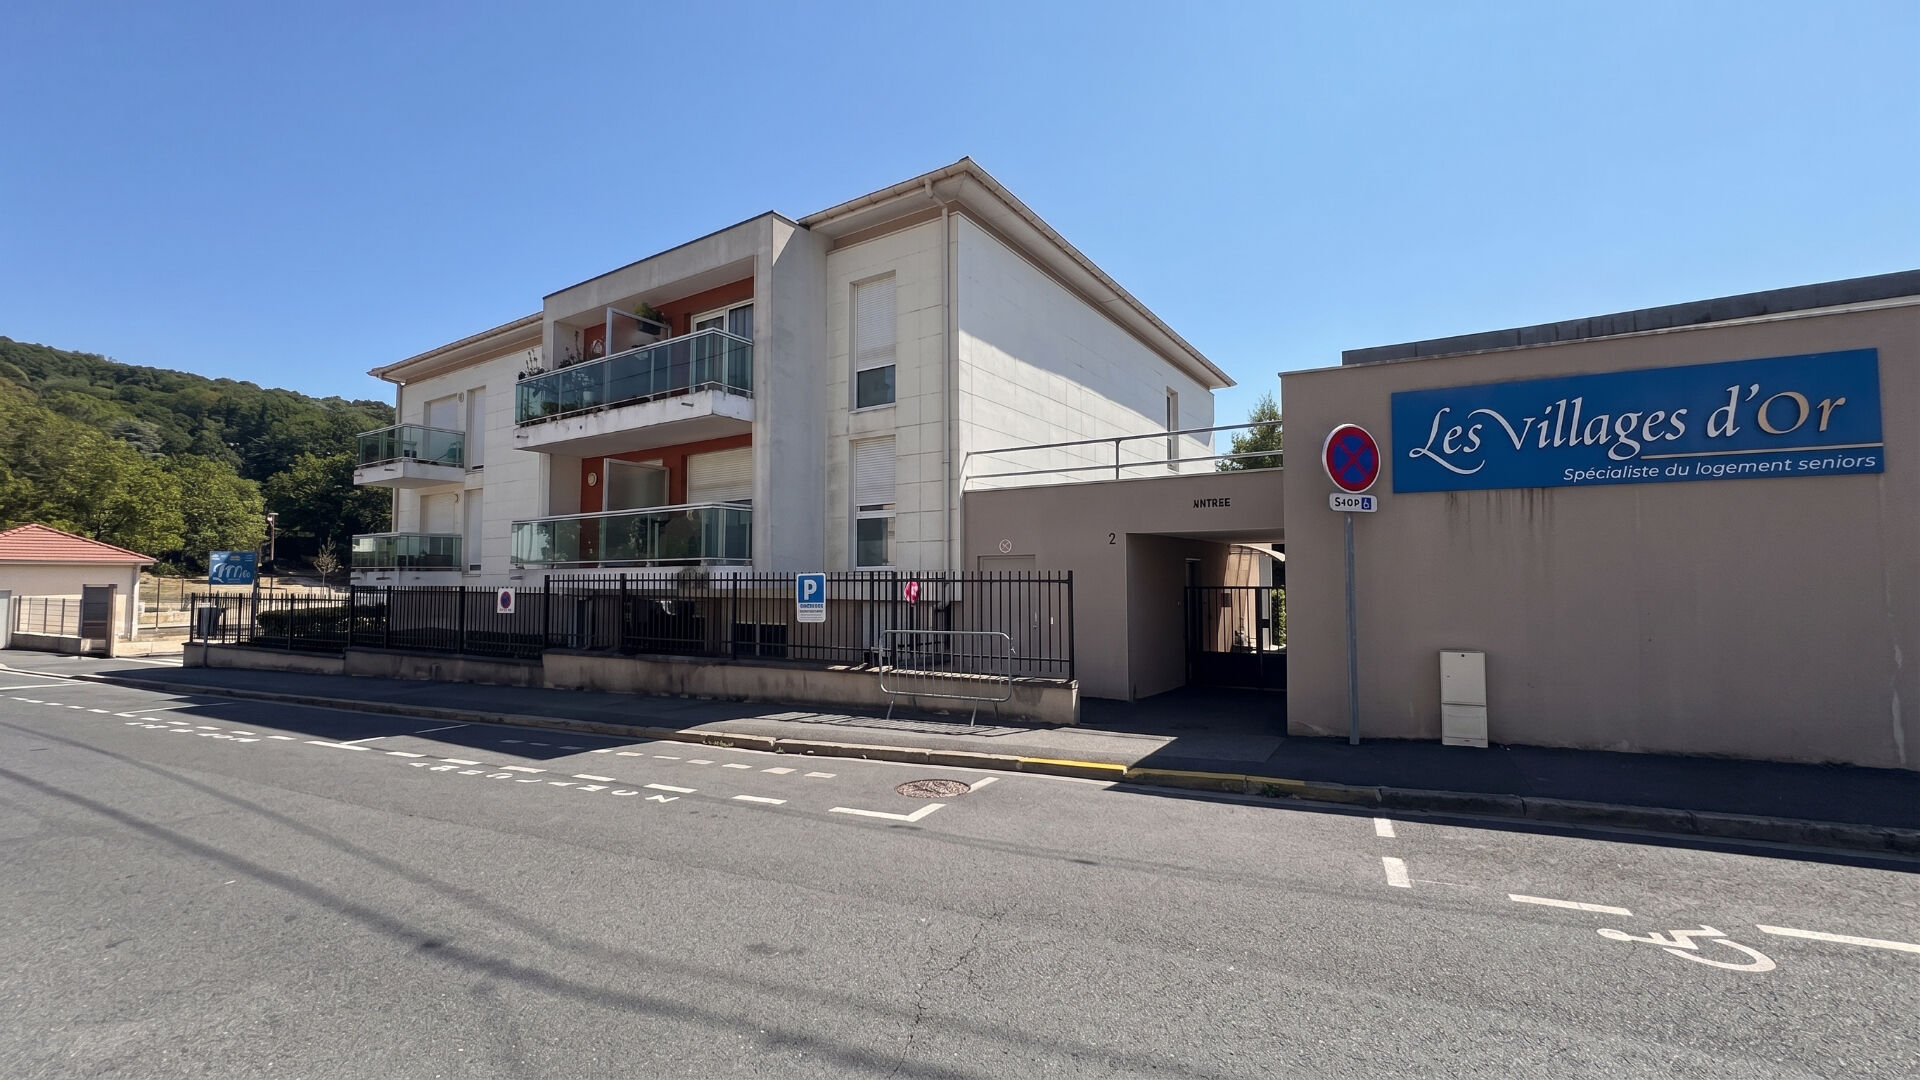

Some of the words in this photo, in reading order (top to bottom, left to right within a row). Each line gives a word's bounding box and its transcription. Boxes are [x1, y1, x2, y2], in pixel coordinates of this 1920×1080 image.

[1409, 408, 1485, 475] Les
[1468, 397, 1687, 460] Villages
[1706, 384, 1846, 438] d'Or
[1563, 465, 1659, 483] Spécialiste
[1664, 464, 1690, 476] du
[1696, 458, 1793, 477] logement
[1798, 454, 1876, 470] seniors
[1108, 532, 1117, 544] 2
[803, 579, 817, 601] P
